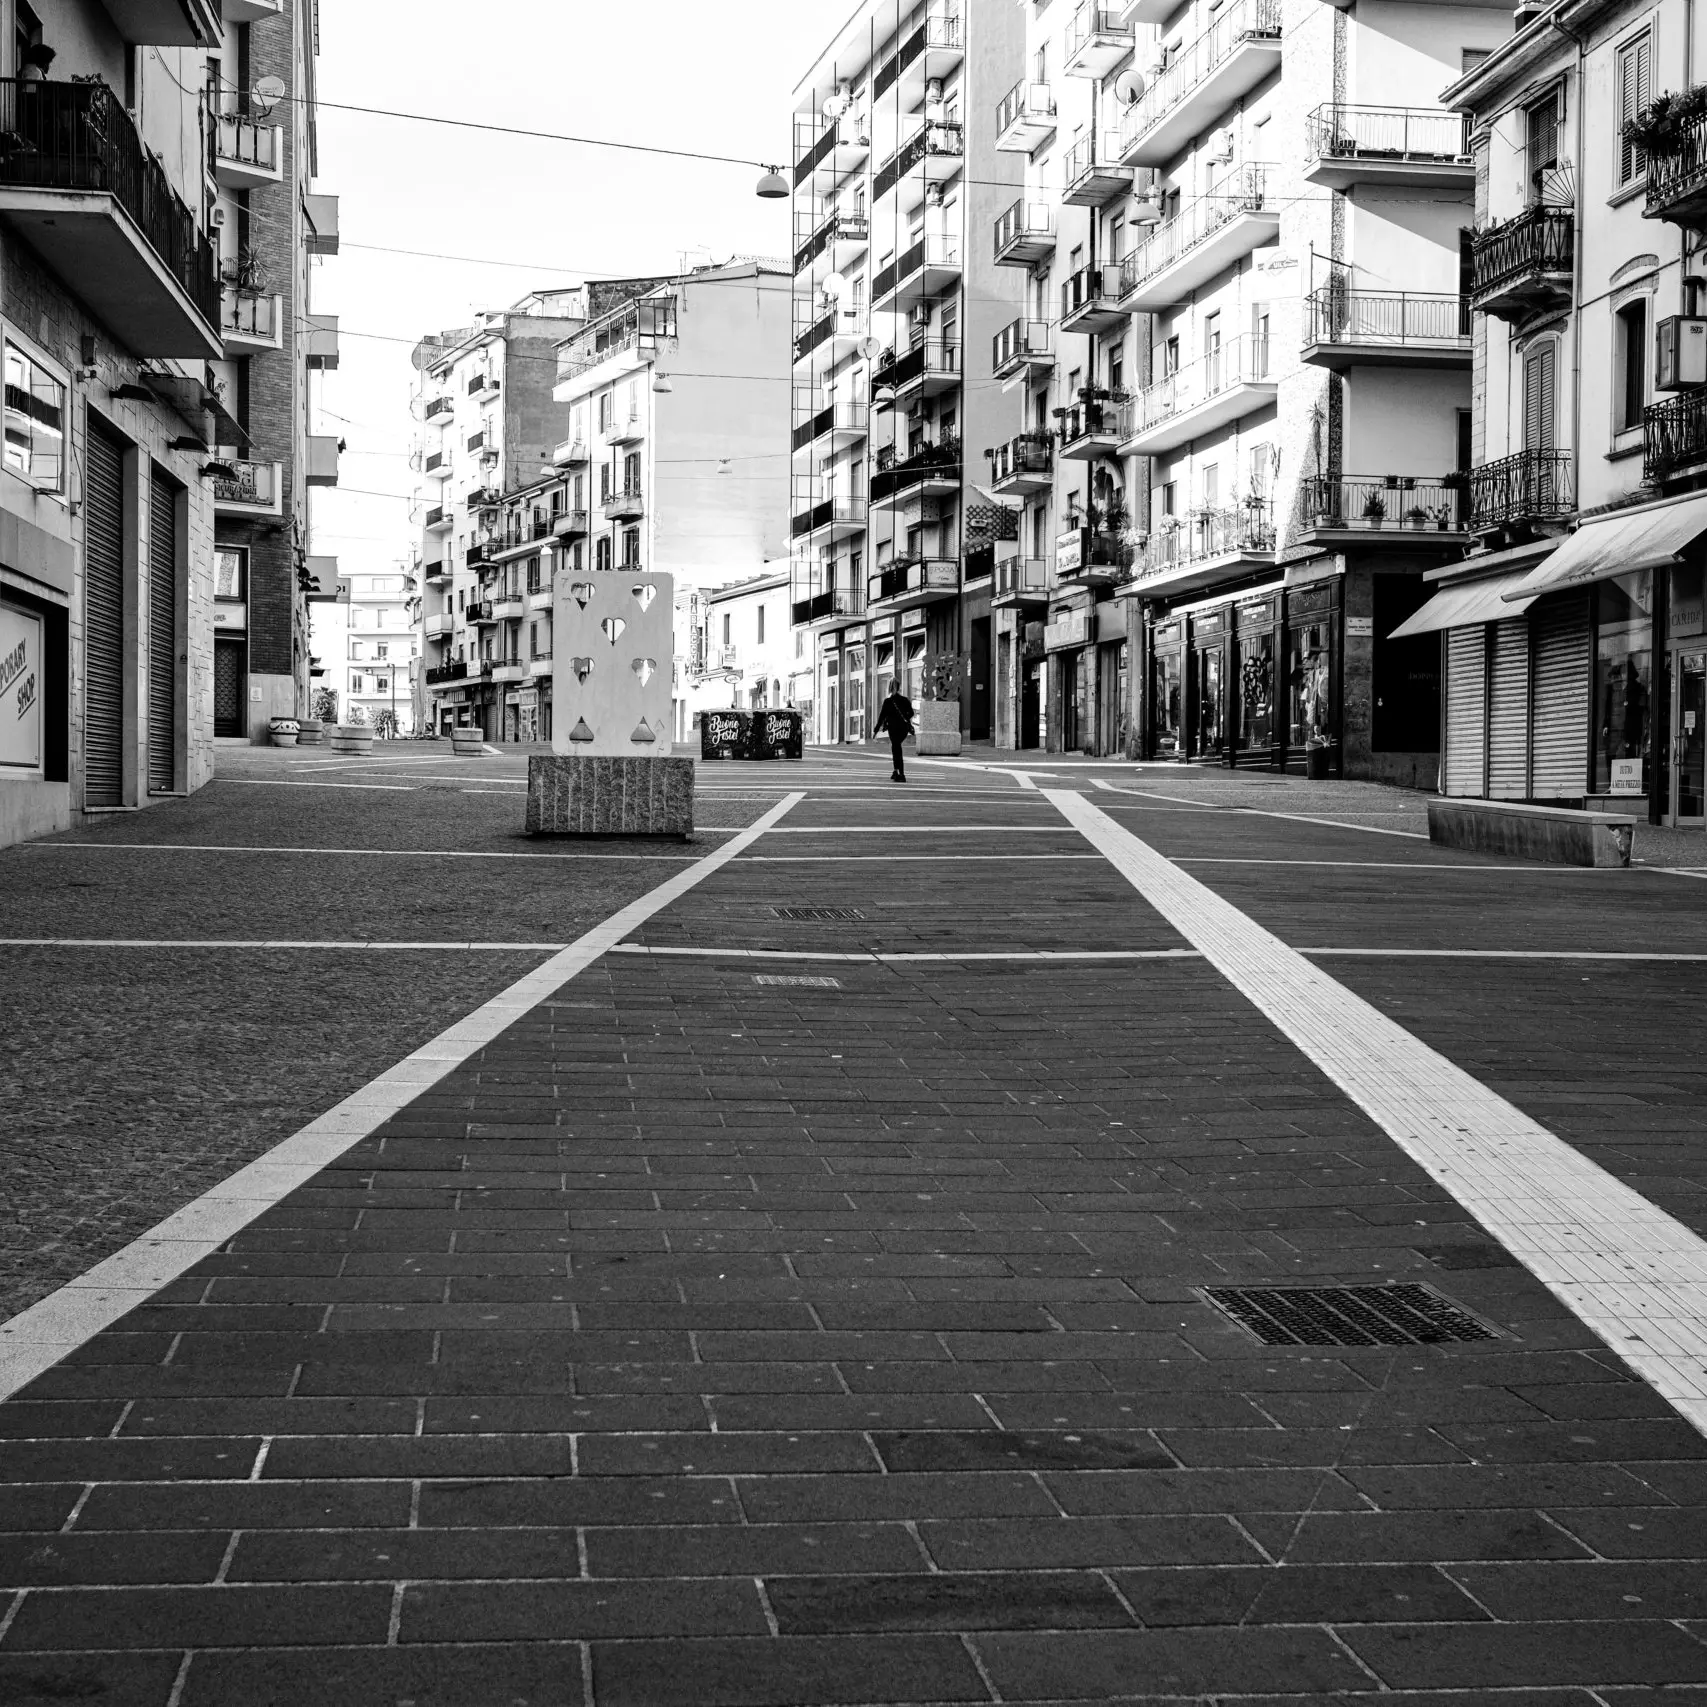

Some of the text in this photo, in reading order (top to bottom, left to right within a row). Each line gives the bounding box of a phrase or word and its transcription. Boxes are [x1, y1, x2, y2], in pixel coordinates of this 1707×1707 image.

[17, 672, 35, 714] SHOP
[709, 715, 739, 732] Buone
[767, 715, 791, 732] Buone
